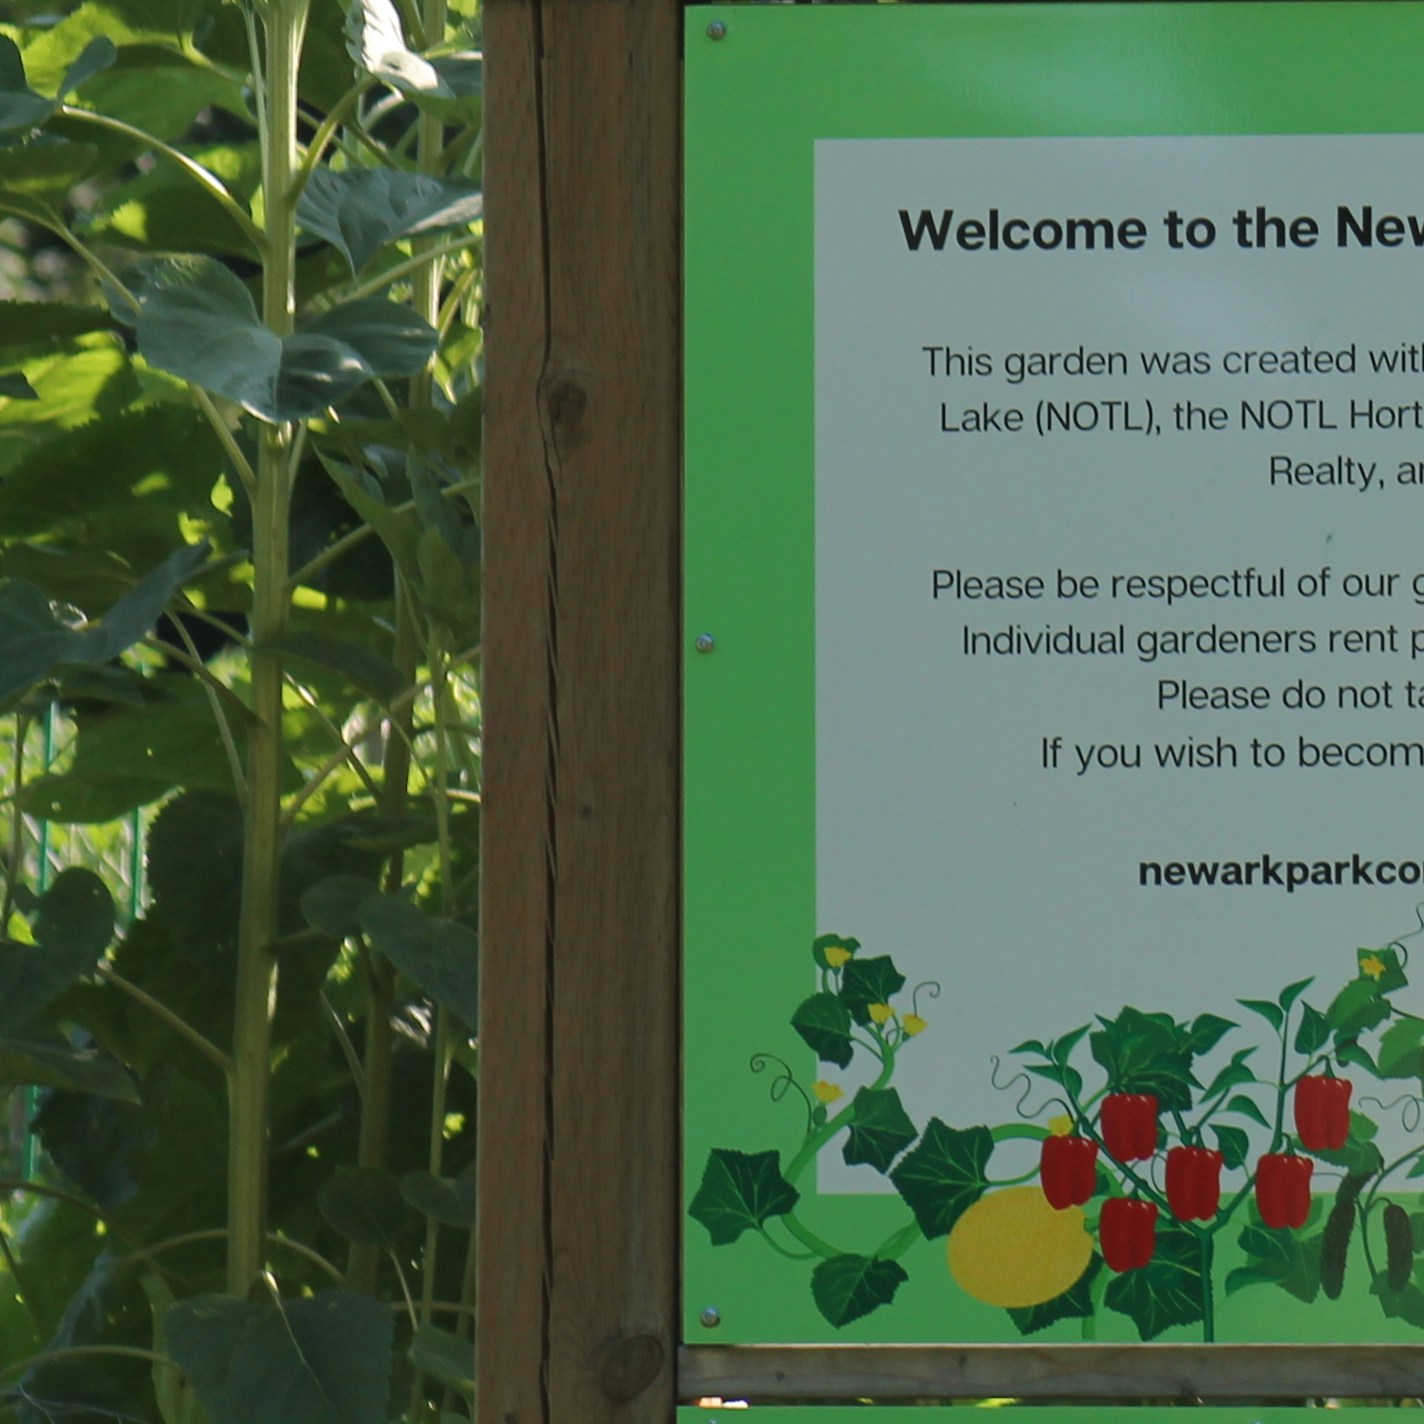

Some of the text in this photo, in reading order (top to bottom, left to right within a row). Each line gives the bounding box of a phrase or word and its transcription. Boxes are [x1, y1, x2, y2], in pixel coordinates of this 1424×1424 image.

[897, 208, 1148, 252] Welcome
[1162, 210, 1217, 250] to
[1231, 205, 1320, 249] the
[921, 345, 993, 377] This
[1004, 344, 1128, 385] garden
[1140, 351, 1212, 375] was
[1222, 342, 1356, 375] created
[940, 401, 1024, 433] Lake
[1035, 398, 1161, 437] (NOTL),
[1172, 400, 1229, 431] the
[1241, 399, 1338, 431] NOTL
[1270, 454, 1385, 493] Realty,
[932, 569, 1045, 600] Please
[1056, 568, 1100, 599] be
[1111, 566, 1285, 606] respectful
[1297, 565, 1332, 598] of
[1342, 573, 1401, 598] our
[963, 623, 1125, 656] Individual
[1136, 623, 1317, 663] gardeners
[1328, 624, 1399, 654] rent
[1158, 679, 1271, 711] Please
[1282, 678, 1326, 710] do
[1338, 680, 1394, 709] not
[1042, 736, 1063, 769] If
[1074, 743, 1141, 777] you
[1153, 735, 1238, 769] wish
[1249, 737, 1286, 768] to
